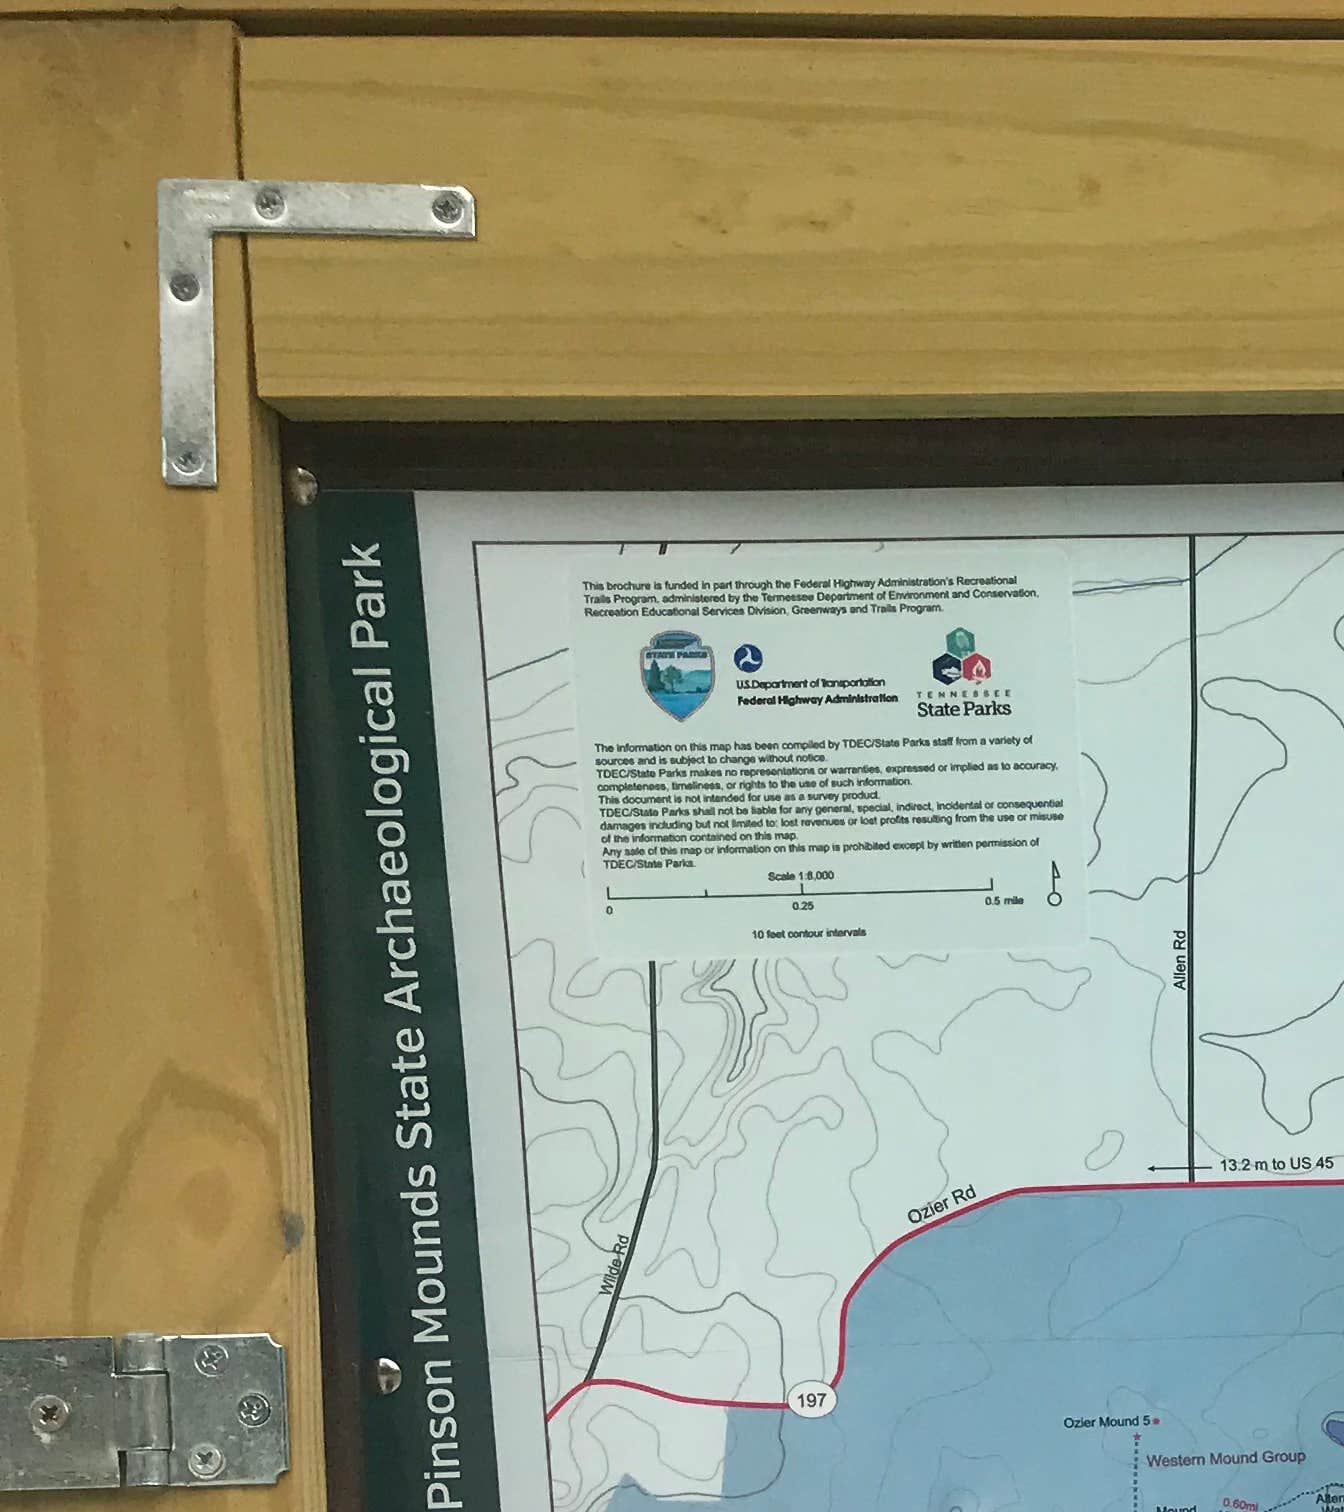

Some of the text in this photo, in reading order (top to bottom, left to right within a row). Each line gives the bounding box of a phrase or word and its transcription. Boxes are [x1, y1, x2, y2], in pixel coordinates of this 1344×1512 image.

[737, 692, 898, 706] Federal Highway Administration
[917, 700, 1012, 717] State Parks
[1172, 929, 1187, 991] Allen Rd
[341, 542, 463, 1510] Pinson Mounds State Archaeological Park
[1220, 1155, 1334, 1172] 13.2 m to US 45
[907, 1184, 977, 1224] Ozier Rd
[599, 1233, 630, 1295] Wilde Rd
[797, 1392, 826, 1408] 197
[1145, 1447, 1307, 1469] Western Mound Group
